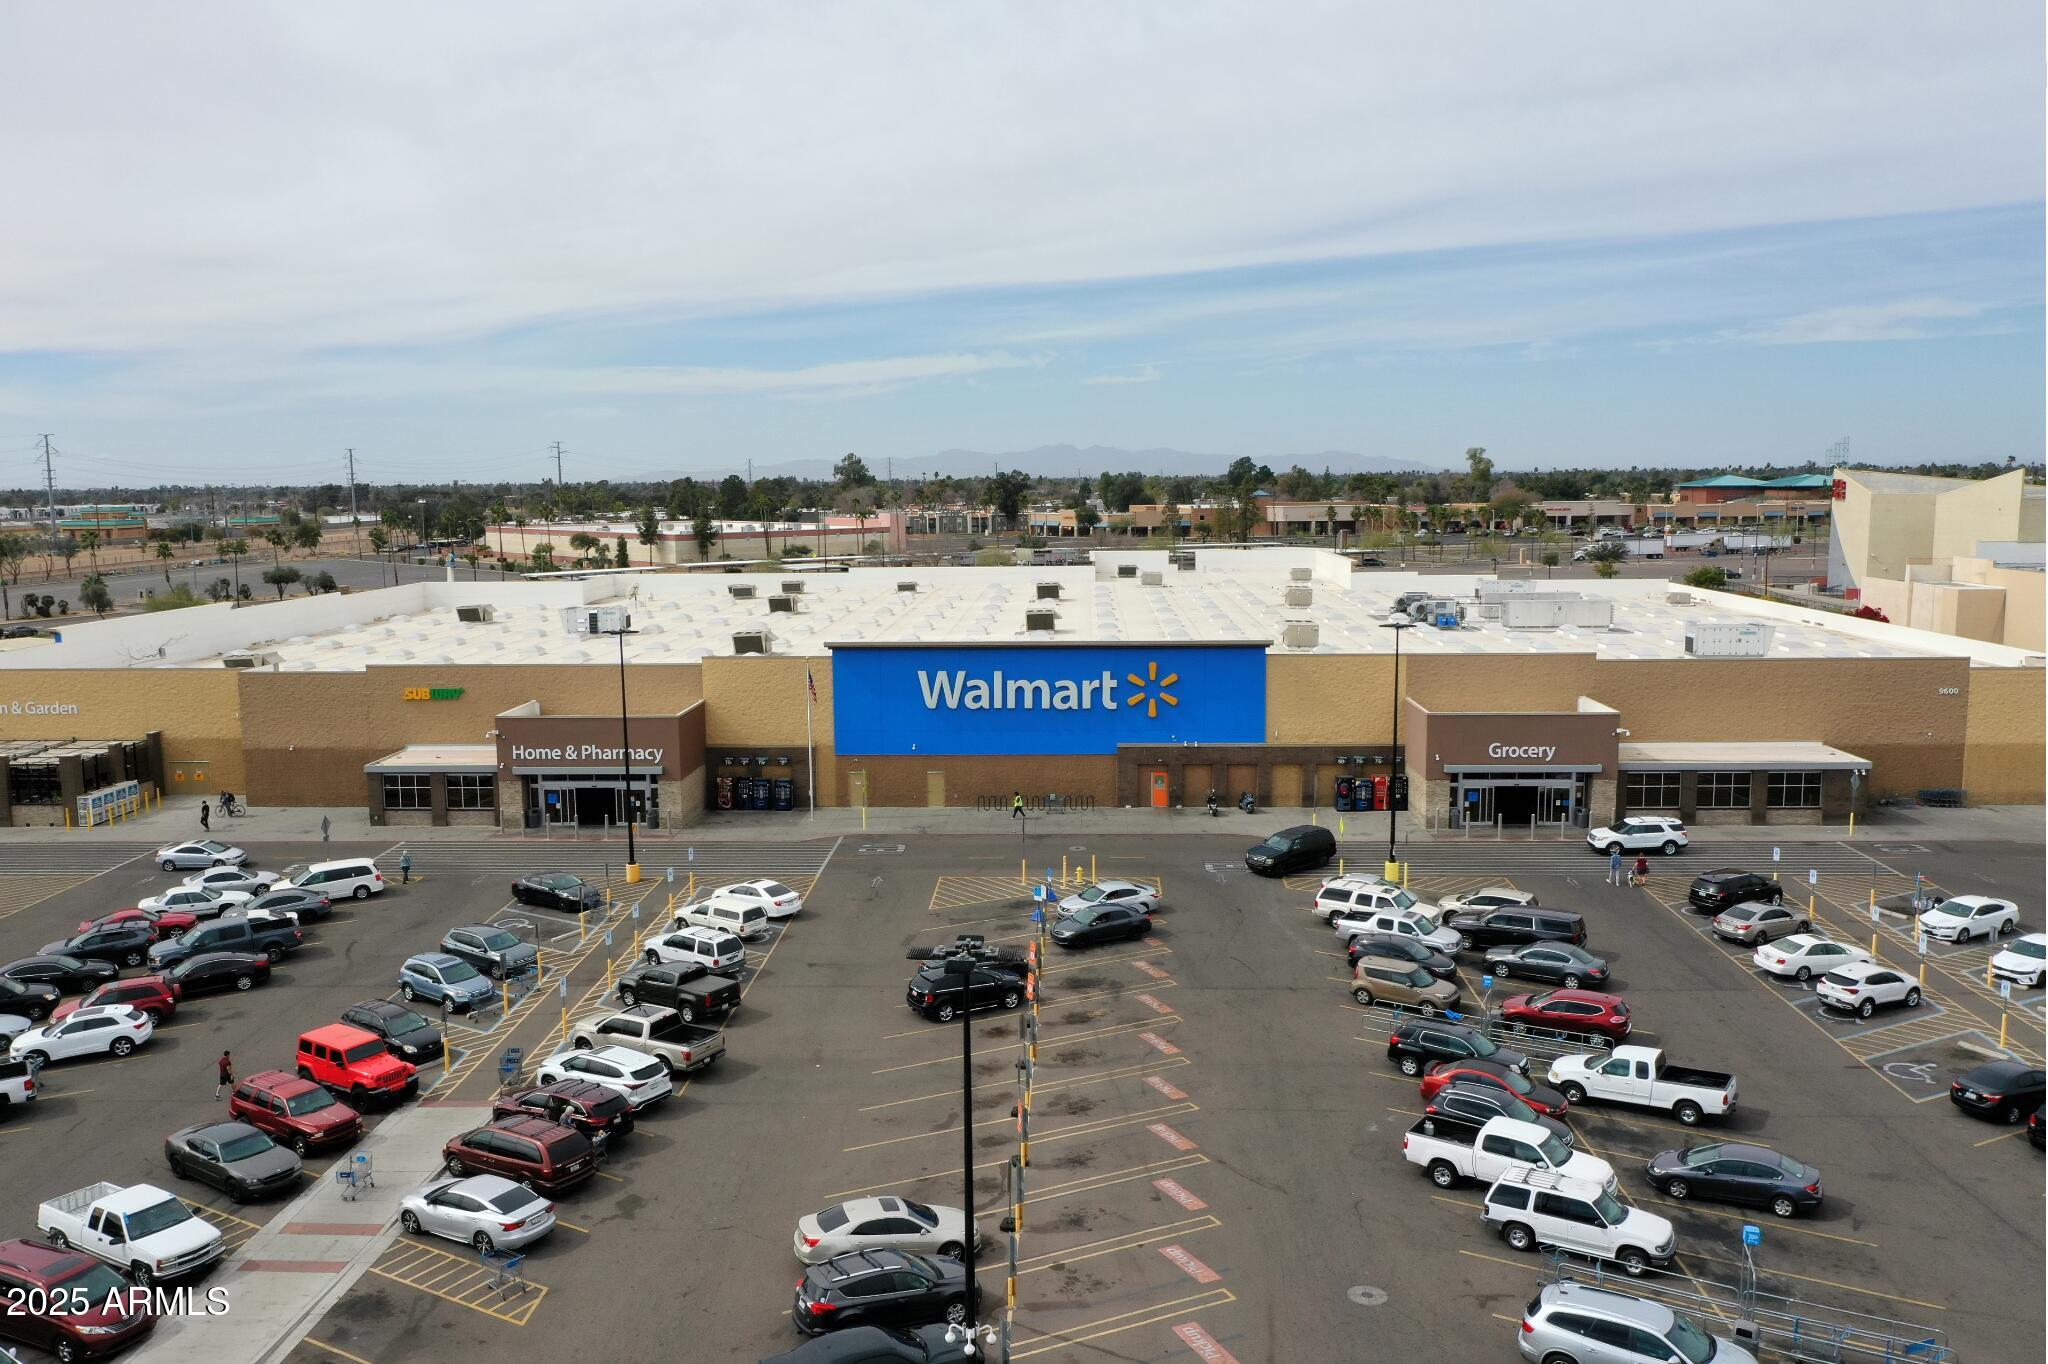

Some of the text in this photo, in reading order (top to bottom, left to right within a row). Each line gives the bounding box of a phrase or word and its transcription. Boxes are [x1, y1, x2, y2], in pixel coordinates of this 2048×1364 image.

[404, 687, 465, 700] SUBWAY
[917, 670, 1118, 710] Walmart
[1938, 687, 1959, 695] 9600
[11, 701, 22, 715] &
[25, 701, 78, 715] Garden
[512, 745, 664, 763] Home & Pharmacy
[1488, 742, 1556, 761] Grocery
[1159, 1181, 1193, 1205] Pickup
[1166, 1248, 1204, 1279] Pickup
[1183, 1326, 1223, 1360] Pickup
